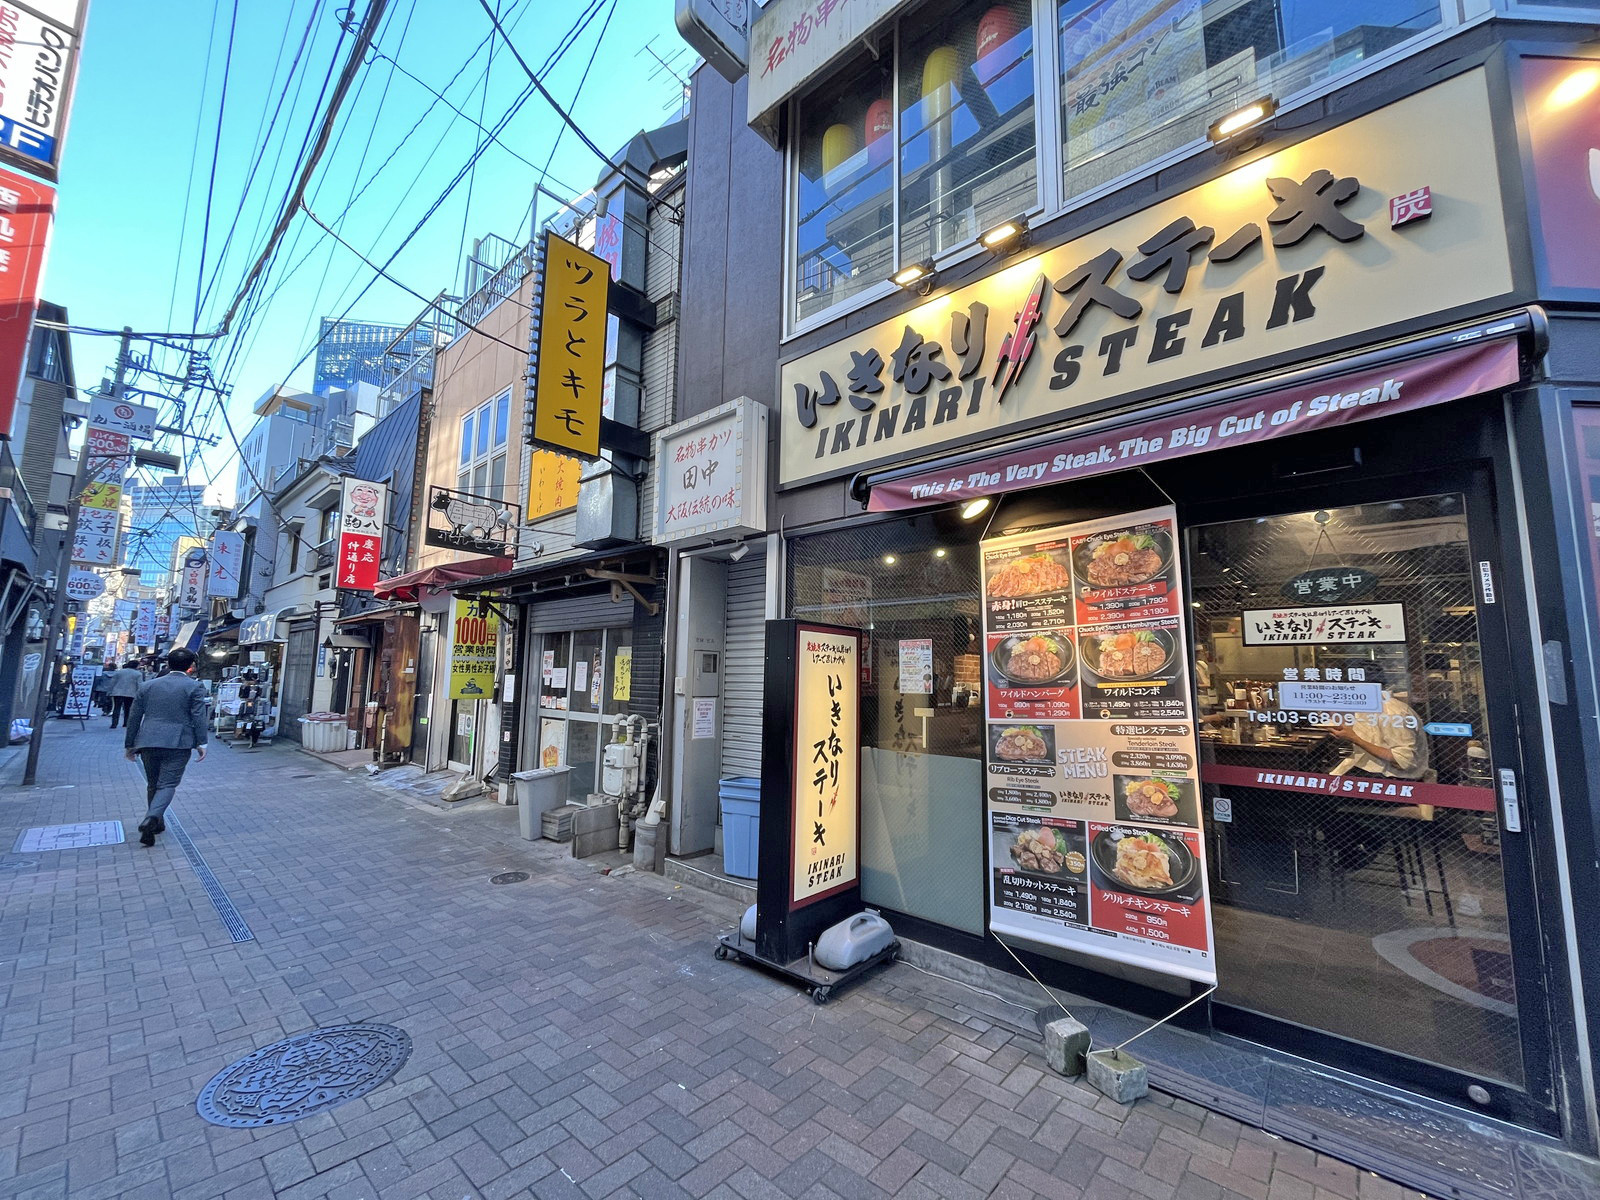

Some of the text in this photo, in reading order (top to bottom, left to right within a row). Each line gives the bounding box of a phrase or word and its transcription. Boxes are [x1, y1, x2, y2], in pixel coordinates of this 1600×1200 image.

[794, 301, 989, 428] いきなり
[1390, 188, 1432, 226] 炭
[554, 258, 594, 437] ツラとキモ
[815, 265, 1325, 460] IKINARI STEAK
[674, 428, 732, 463] 名物串カツ
[910, 379, 1404, 500] This is The Very Steak, The Big Cut of Steak
[683, 460, 719, 490] 田中
[665, 487, 735, 524] 大阪伝統の味
[344, 514, 380, 530] 駒八
[344, 541, 359, 584] 仲通り店
[1093, 584, 1156, 599] ワイルドステーキ
[1293, 573, 1362, 595] 営業中
[1127, 621, 1160, 630] Hamburger
[1255, 616, 1382, 633] いきなり ステーキ
[1263, 631, 1377, 641] IKINARI STEAK
[454, 645, 496, 655] 営業時間
[1283, 667, 1366, 681] 営業時間
[1000, 689, 1064, 698] ワイルドハンバーグ
[1104, 687, 1160, 696] ワイルドコンボ
[828, 674, 843, 788] いきなり
[1116, 725, 1187, 735] 特選ヒレステーキ
[1058, 747, 1107, 765] STEAK
[991, 765, 1056, 776] リブロースステーキ
[1063, 761, 1108, 779] MENU
[813, 739, 829, 847] ステーキ
[1257, 773, 1414, 798] IKINARI STEAK
[808, 853, 845, 875] IKINARI
[808, 865, 842, 888] STEAK
[1003, 875, 1076, 896] 乱切りカットステーキ
[1102, 892, 1191, 917] グリルチキンステーキ
[1141, 927, 1169, 939] 1,500円
